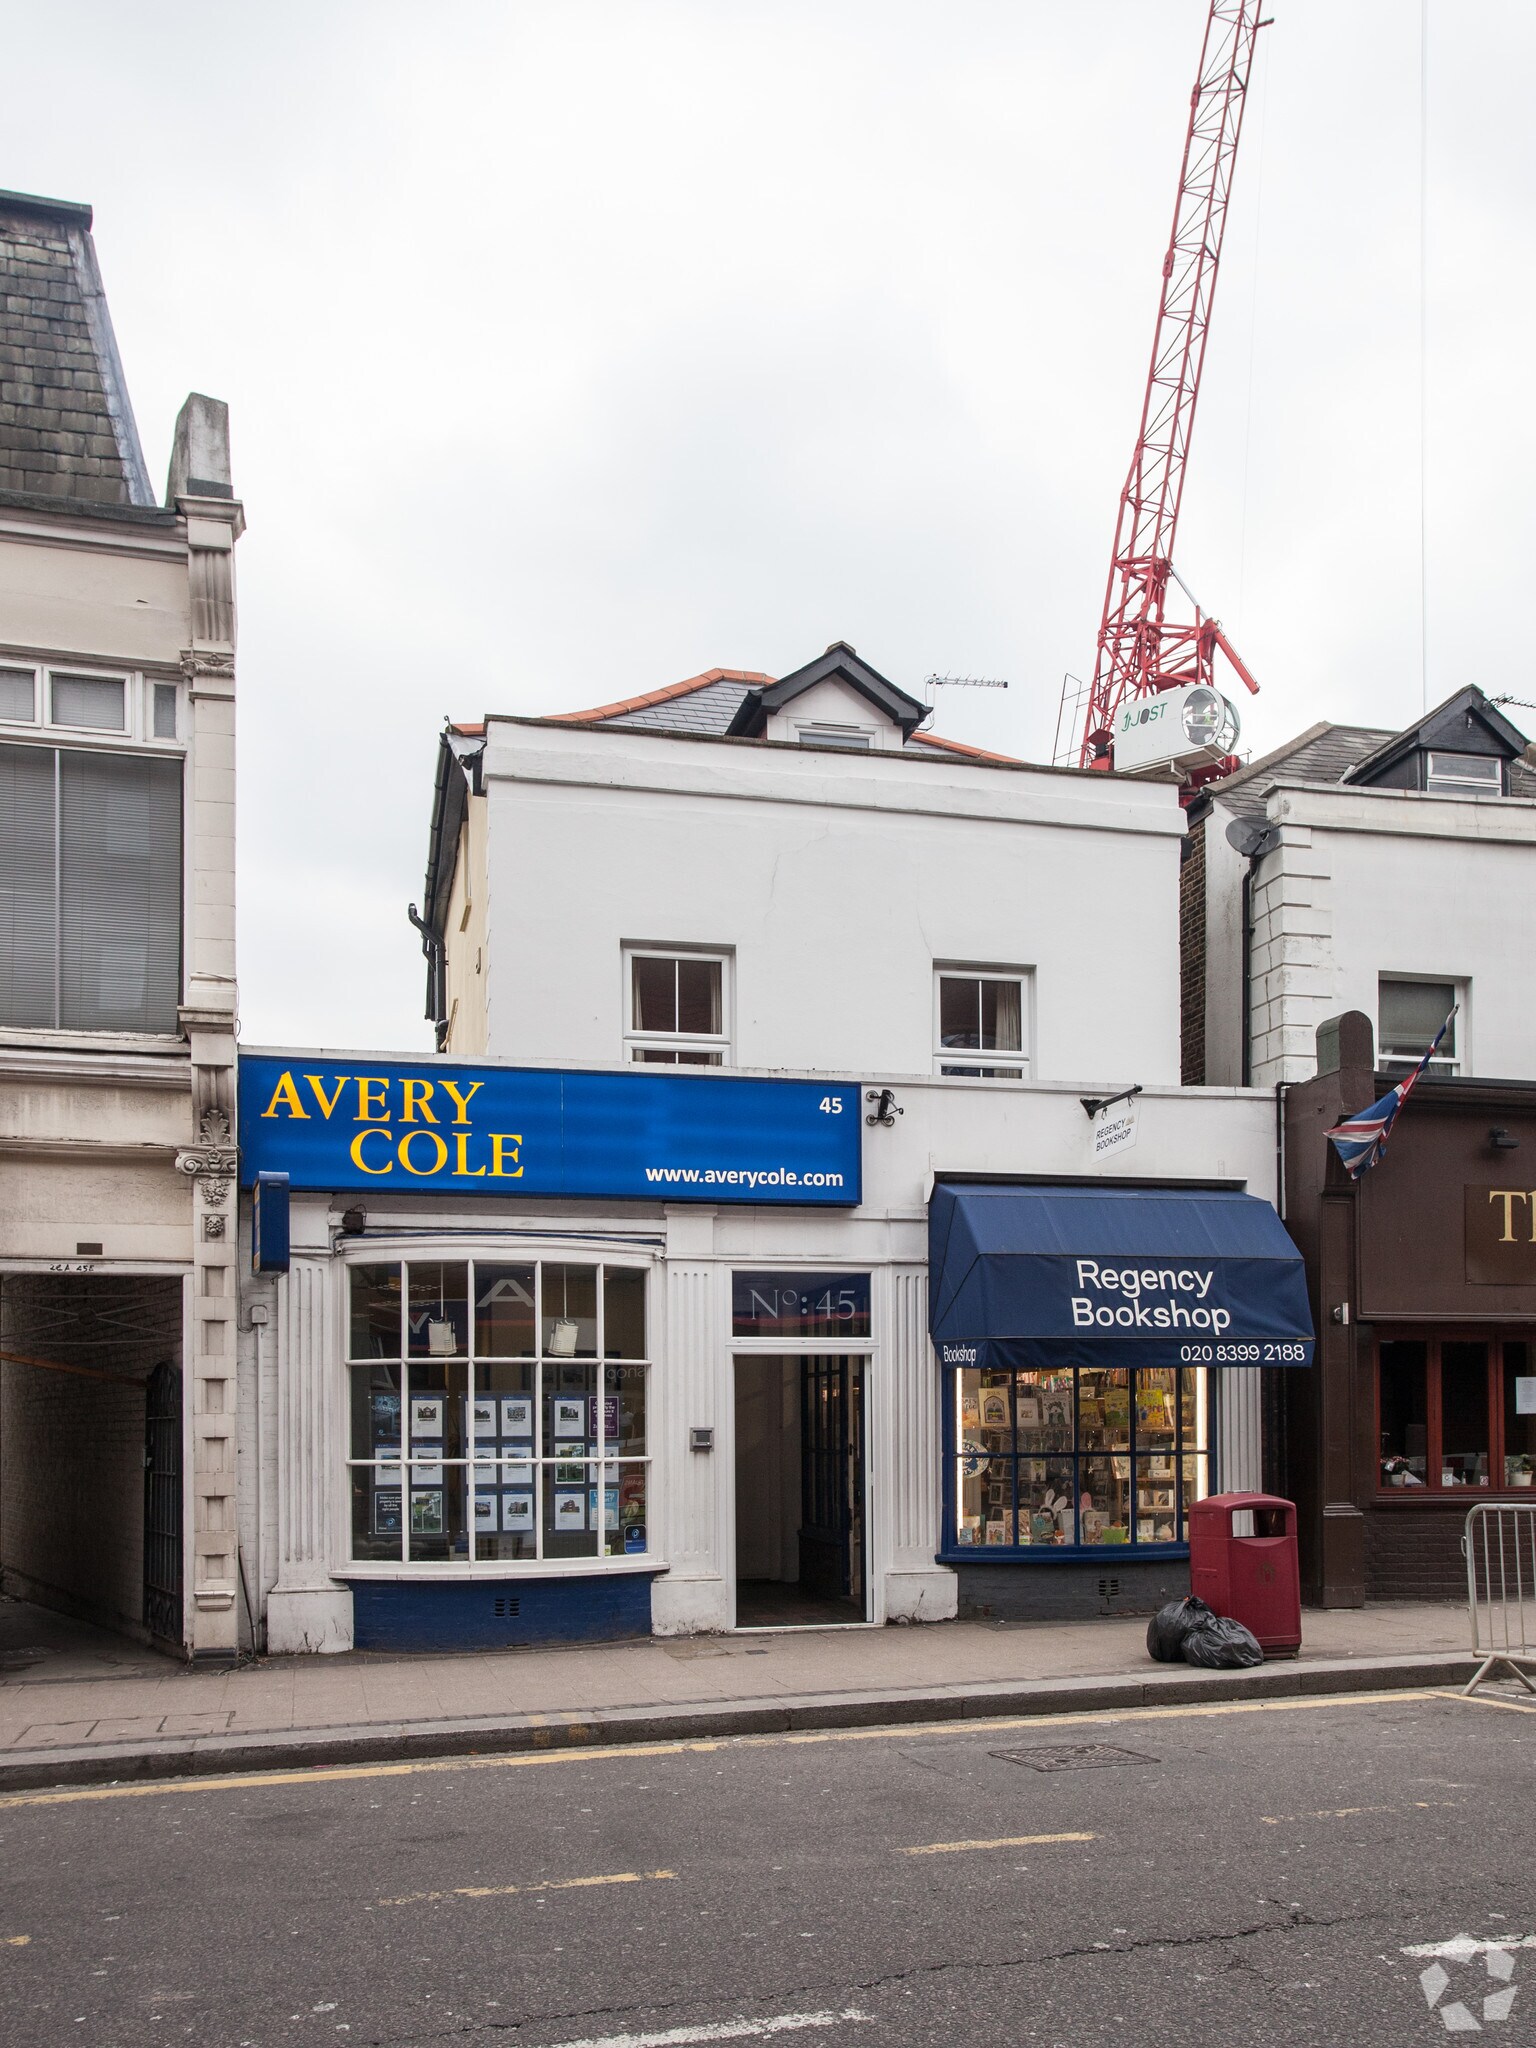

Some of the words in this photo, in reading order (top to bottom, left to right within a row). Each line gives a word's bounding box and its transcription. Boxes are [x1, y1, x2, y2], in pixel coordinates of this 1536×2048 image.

[261, 1071, 485, 1125] AVERY
[819, 1097, 844, 1115] 45
[1096, 1118, 1126, 1140] REGENCY
[1096, 1128, 1132, 1151] BOOKSHOP
[349, 1128, 525, 1179] COLE
[645, 1166, 844, 1187] www.averycole.com
[1075, 1259, 1214, 1299] Regency
[1071, 1297, 1231, 1336] Bookshop
[943, 1343, 977, 1367] Bookshop
[1180, 1345, 1213, 1362] 020
[1216, 1345, 1260, 1361] 8399
[1264, 1344, 1305, 1361] 2188
